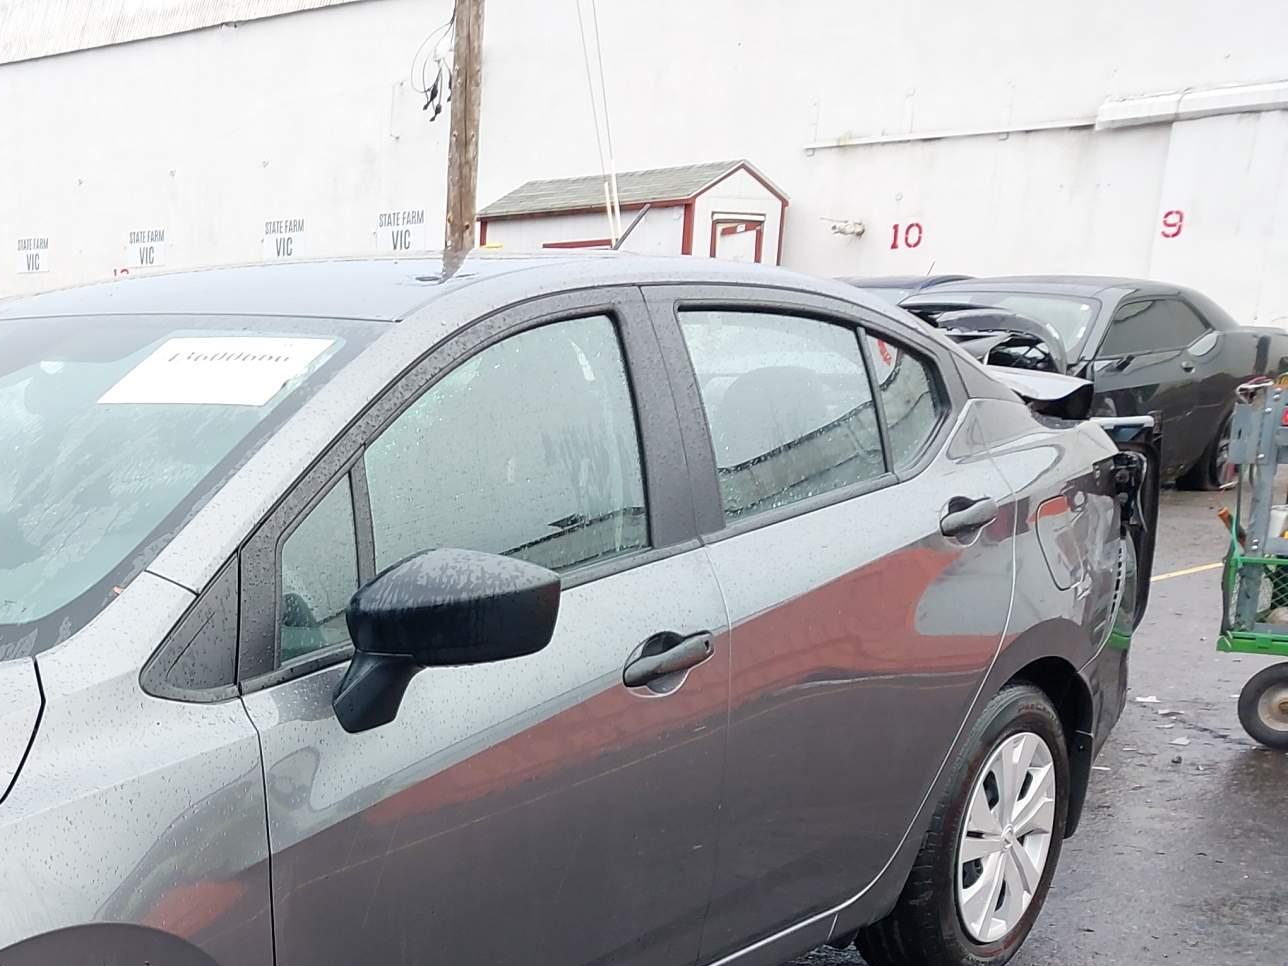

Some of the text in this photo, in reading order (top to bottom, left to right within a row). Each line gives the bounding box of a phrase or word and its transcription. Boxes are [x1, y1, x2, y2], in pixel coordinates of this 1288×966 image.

[265, 218, 305, 235] STATE FARM
[379, 209, 425, 228] STATE FARM
[1161, 210, 1184, 238] 9
[17, 238, 49, 251] STATE FARM
[129, 229, 165, 245] STATE FARM
[391, 229, 411, 251] VIC
[890, 223, 923, 250] 10
[139, 246, 155, 265] VIC
[275, 237, 293, 257] VIC
[26, 253, 40, 271] VIC
